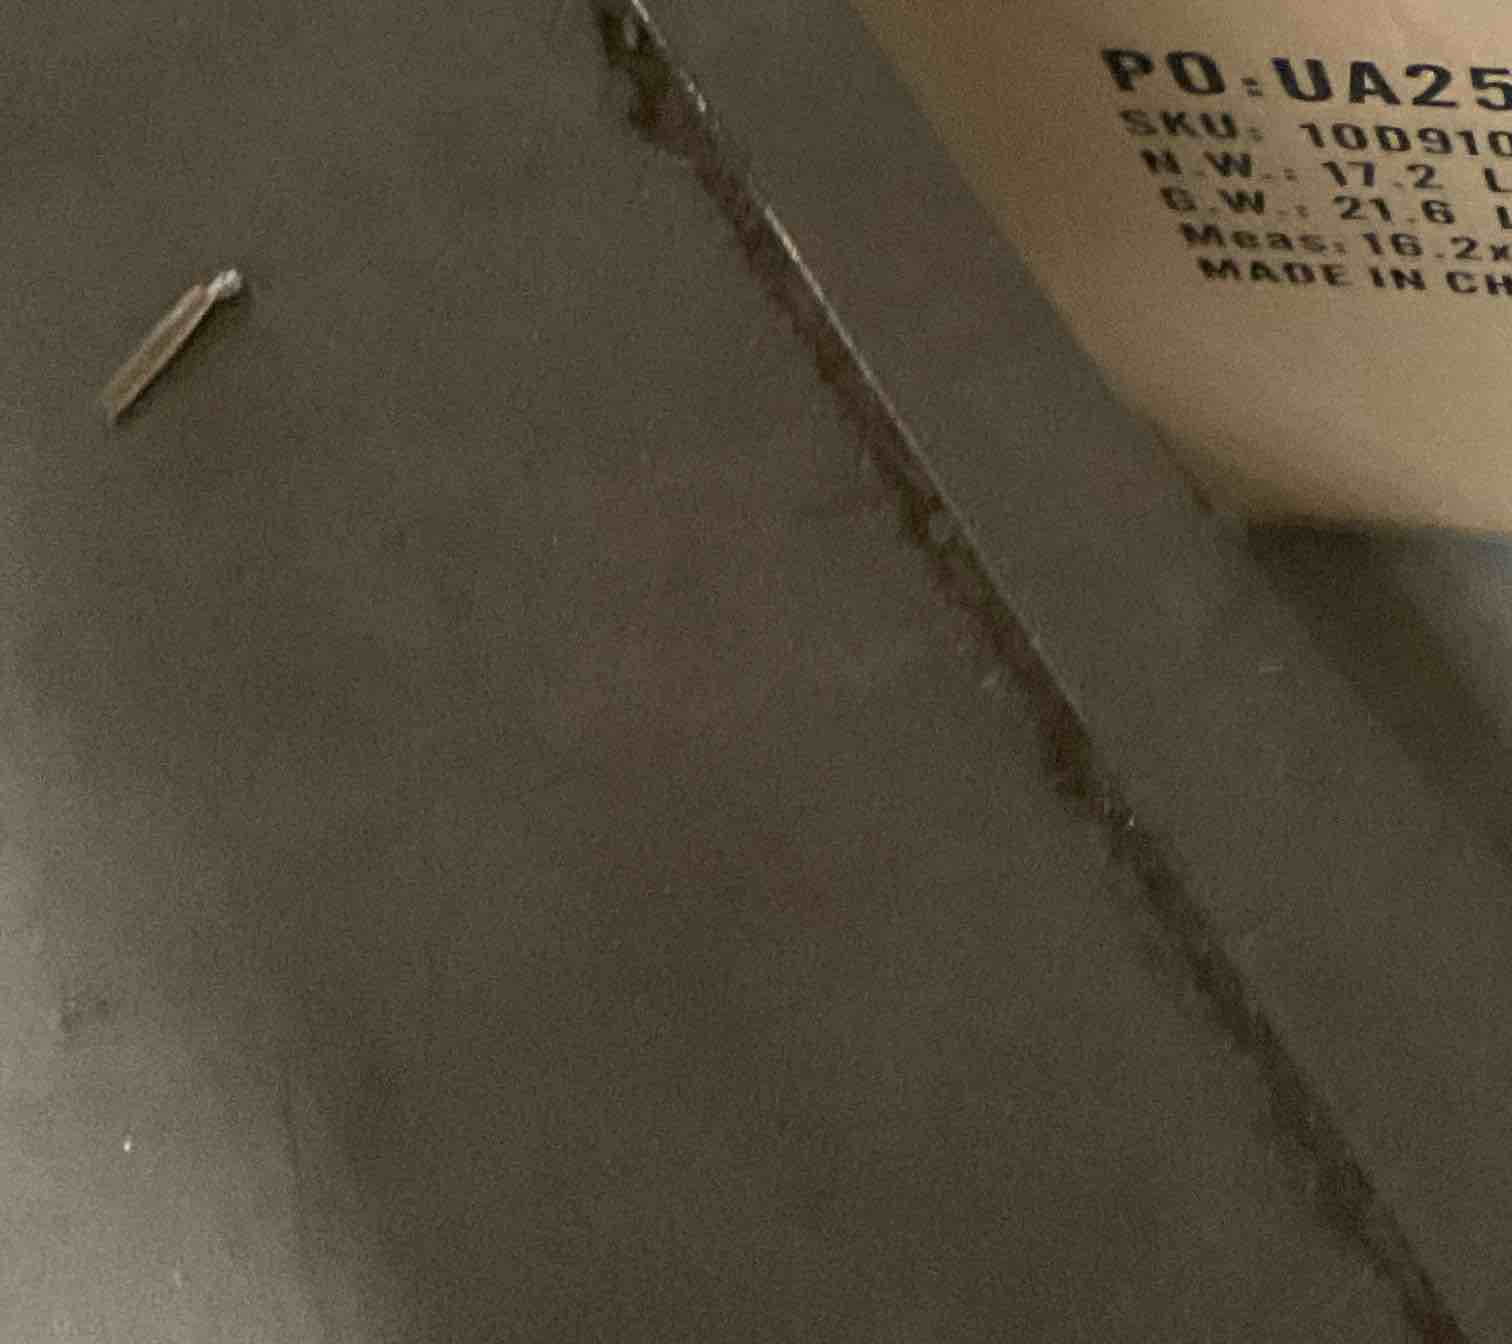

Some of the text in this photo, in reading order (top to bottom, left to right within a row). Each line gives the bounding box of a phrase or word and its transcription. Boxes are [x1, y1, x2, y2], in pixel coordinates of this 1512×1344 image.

[1120, 109, 1264, 143] SKU:
[1322, 160, 1444, 190] 17.2
[1332, 194, 1456, 225] 21.6
[1197, 256, 1350, 287] MADE
[1369, 265, 1427, 292] IN
